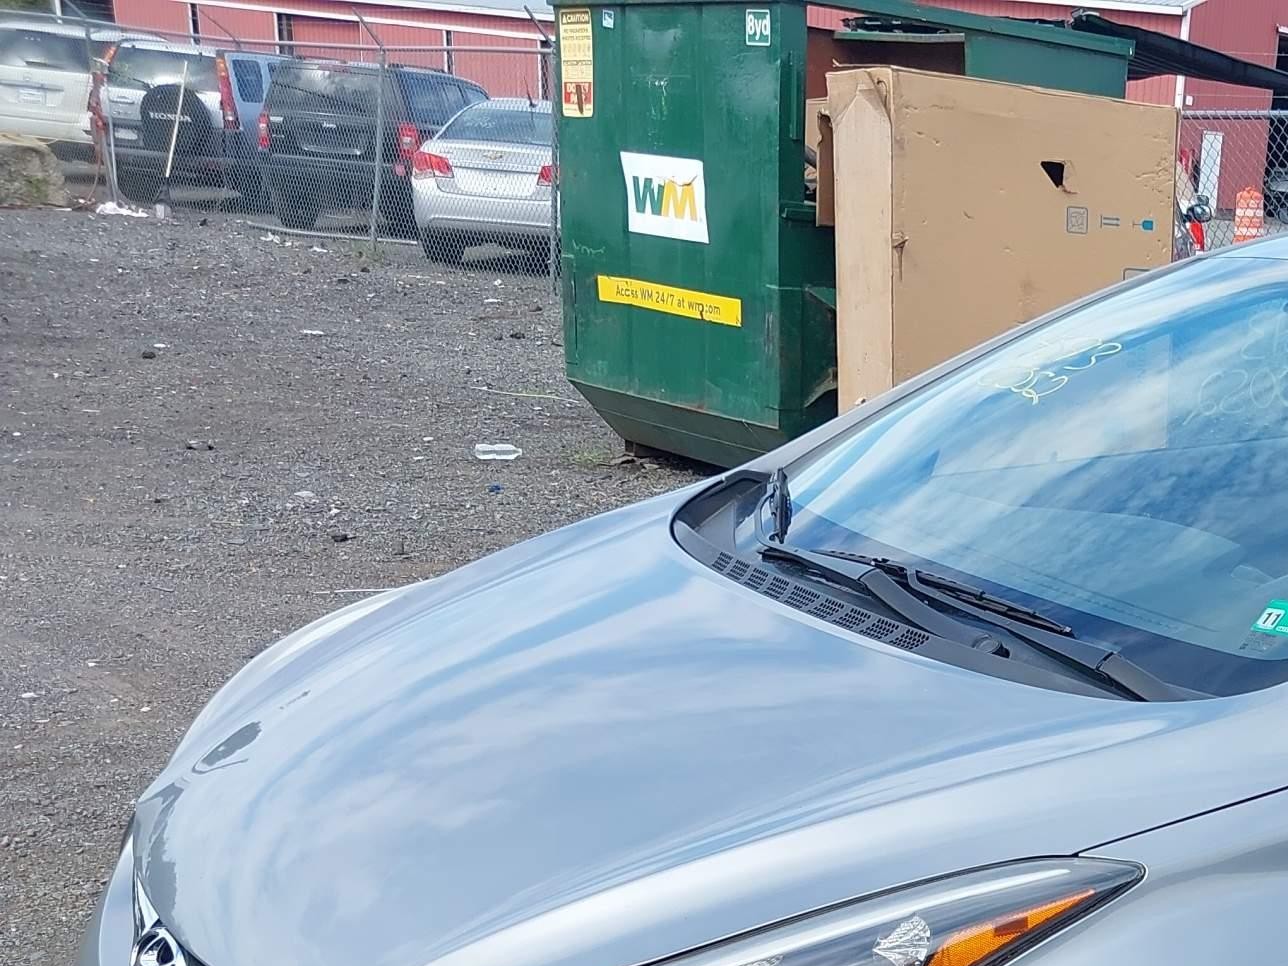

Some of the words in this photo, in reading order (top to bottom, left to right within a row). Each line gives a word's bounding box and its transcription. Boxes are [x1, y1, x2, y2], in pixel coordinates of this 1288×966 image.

[747, 14, 769, 40] 8yd
[632, 175, 698, 222] WM
[640, 287, 653, 302] WM
[656, 291, 675, 307] 24/7
[677, 298, 685, 309] at
[687, 302, 721, 316] wmom
[1262, 611, 1281, 626] 11
